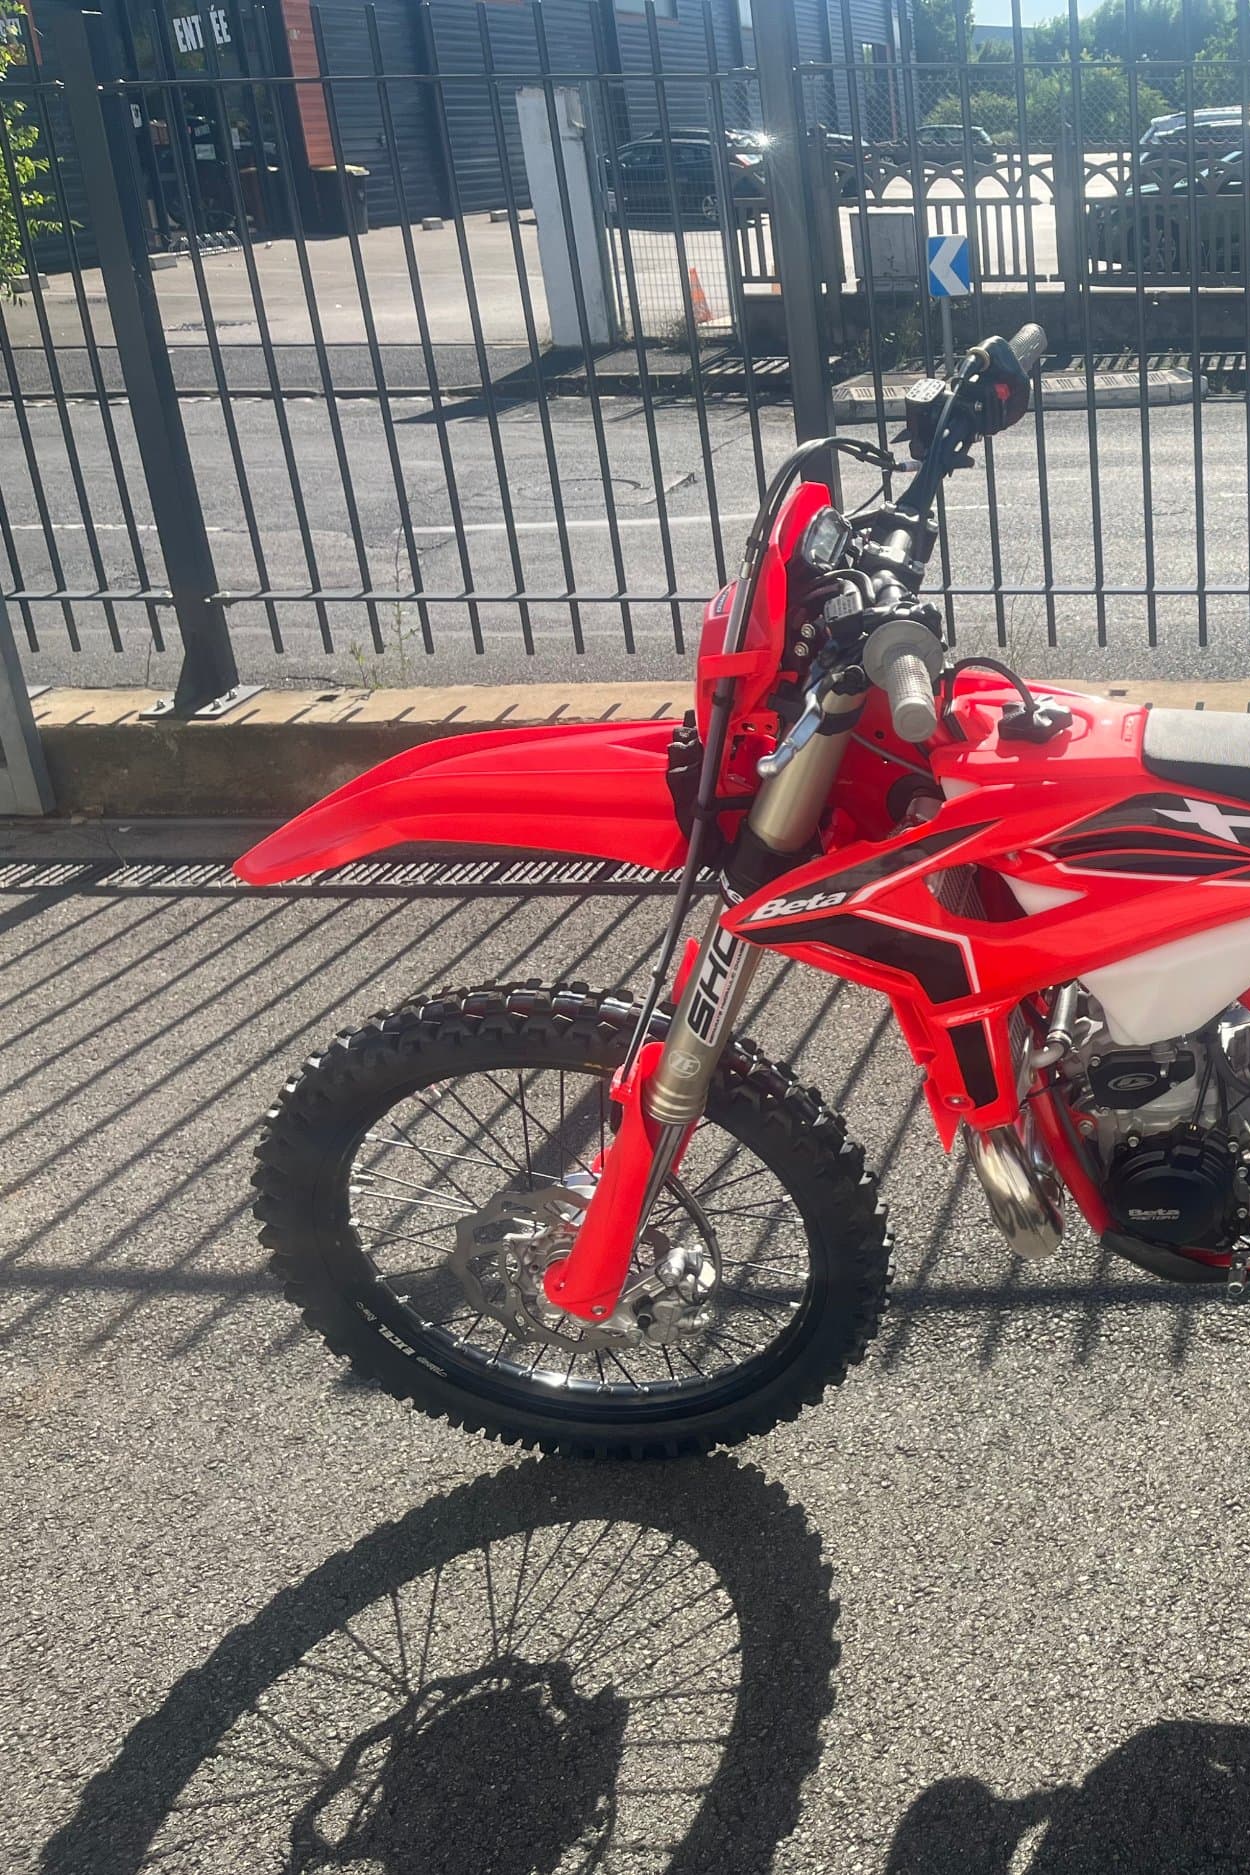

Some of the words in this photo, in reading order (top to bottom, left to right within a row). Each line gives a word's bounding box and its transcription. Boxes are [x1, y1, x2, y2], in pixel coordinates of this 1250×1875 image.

[172, 4, 232, 53] ENTÉE
[749, 891, 848, 921] Beta
[377, 1323, 416, 1356] EXCEL
